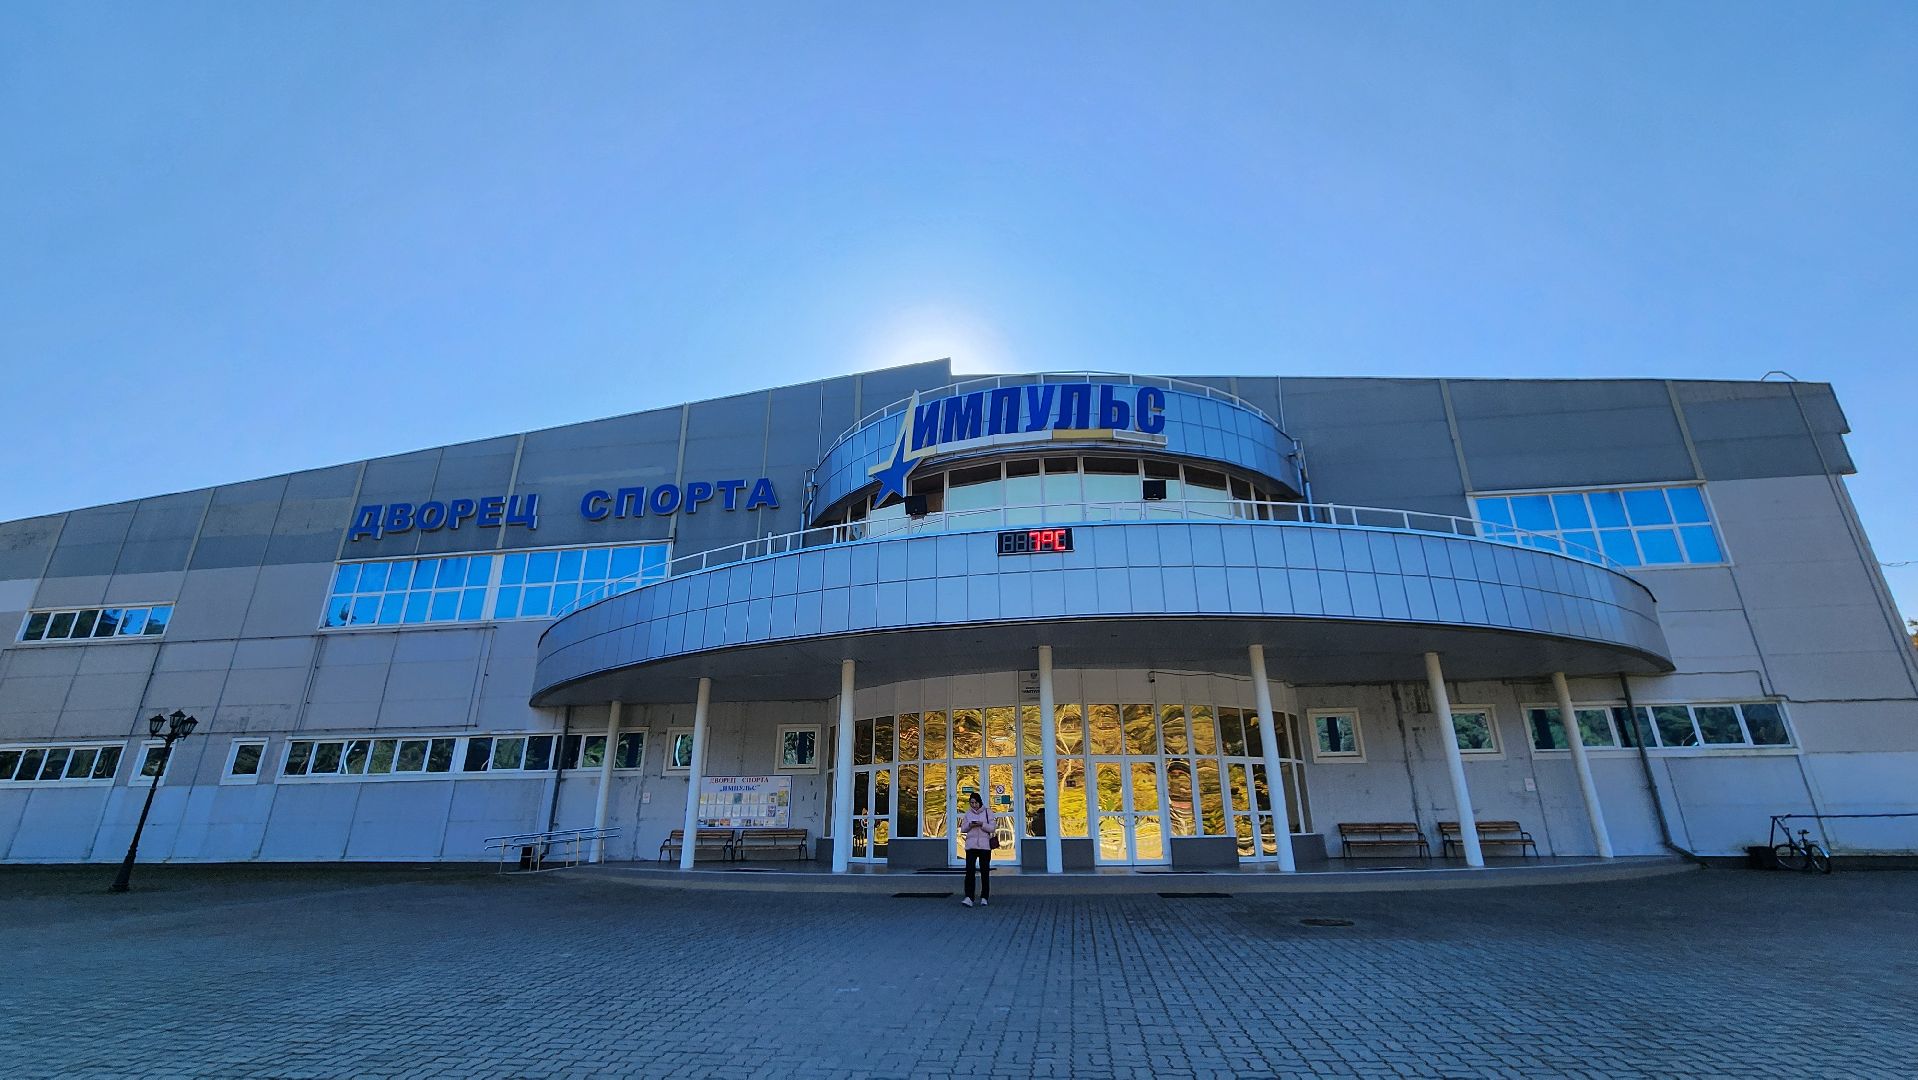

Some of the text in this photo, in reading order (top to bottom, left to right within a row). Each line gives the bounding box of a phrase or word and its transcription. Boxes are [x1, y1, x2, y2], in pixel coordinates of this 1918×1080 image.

[912, 384, 1166, 451] ИМПУЛЬС
[349, 478, 779, 540] ДВОРЕЦ СПОРТА
